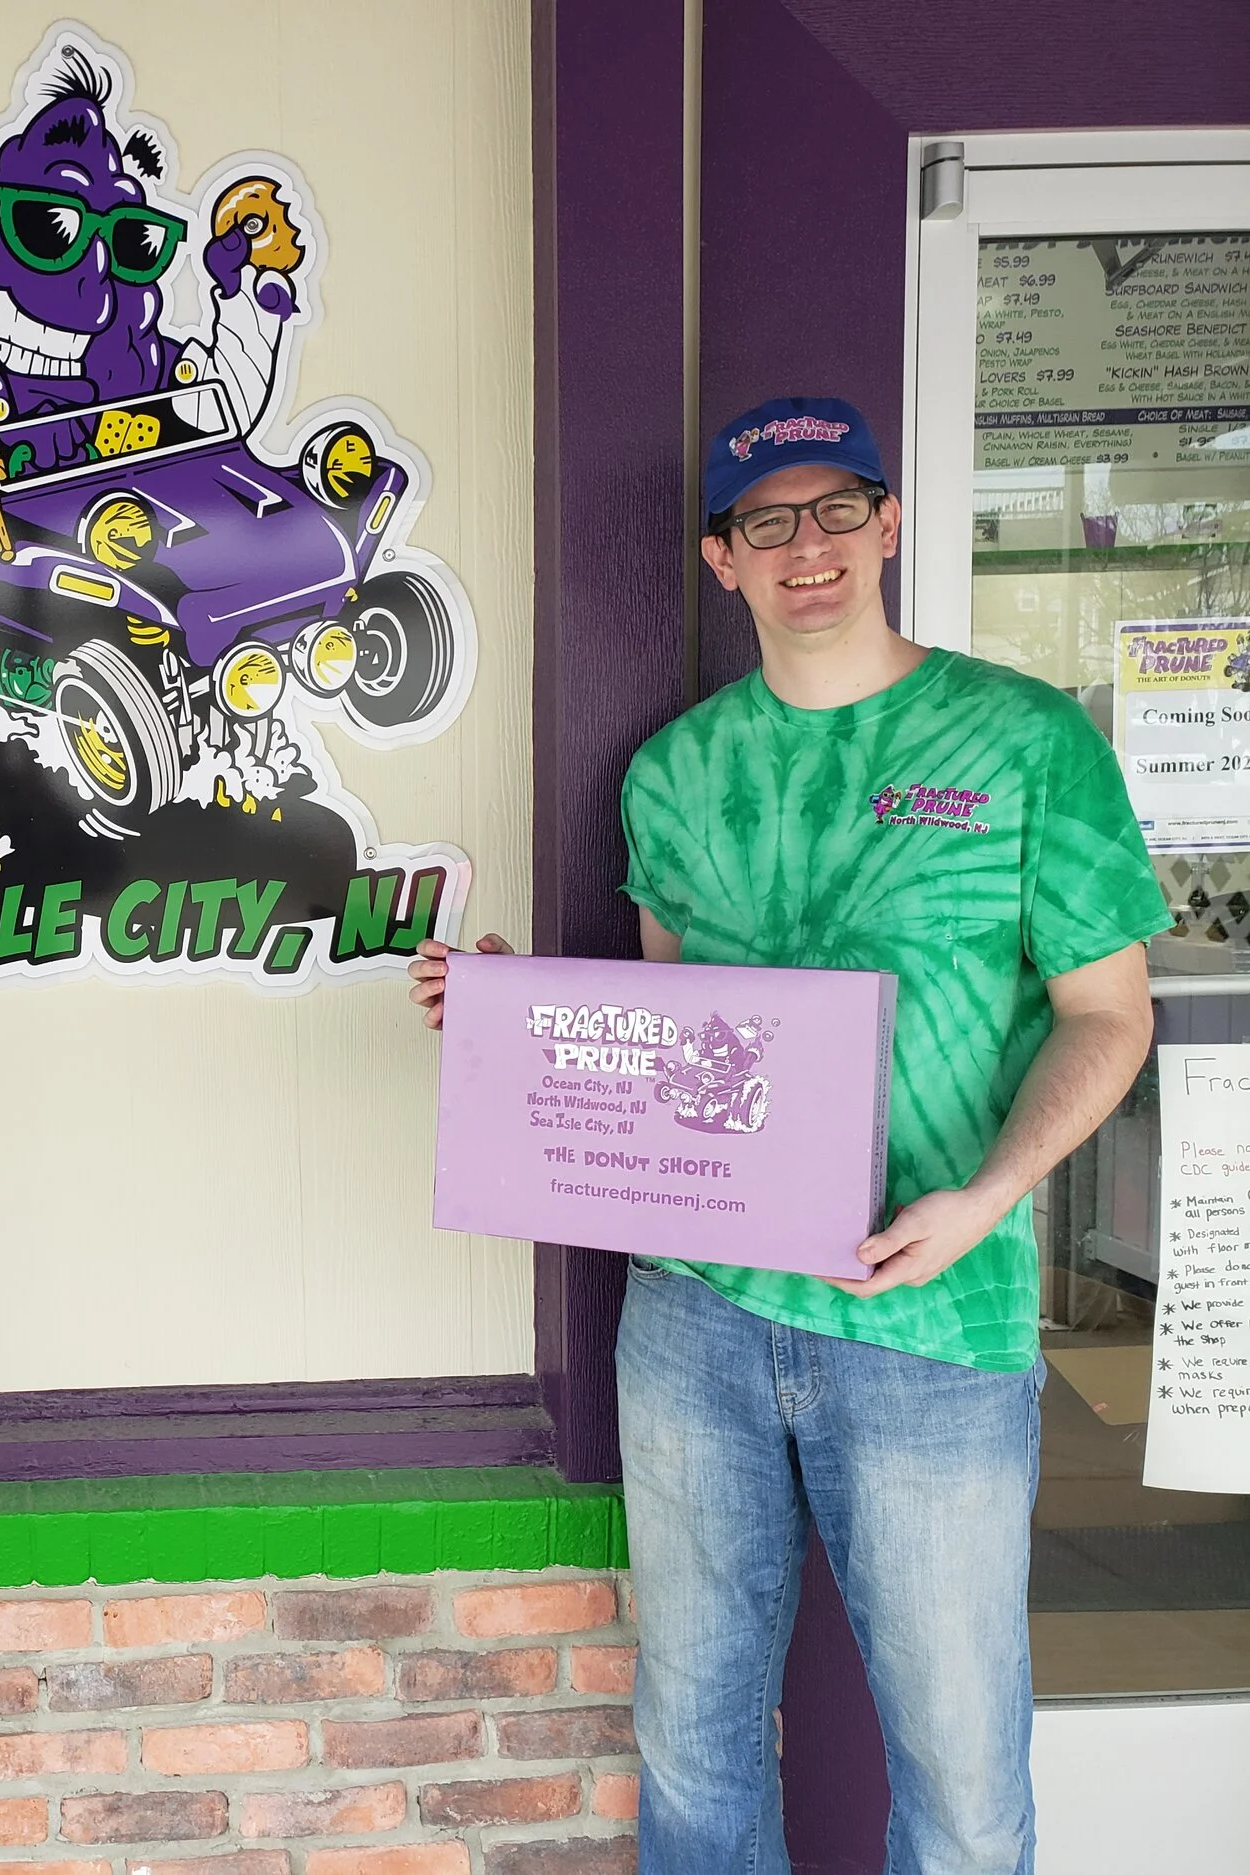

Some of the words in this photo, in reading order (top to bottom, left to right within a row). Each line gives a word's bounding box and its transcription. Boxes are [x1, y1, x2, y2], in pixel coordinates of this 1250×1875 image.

[993, 256, 1030, 268] $5.99
[1183, 267, 1209, 276] MEAT
[1213, 267, 1227, 276] ON
[1019, 274, 1056, 286] $6.99
[1185, 282, 1247, 294] SANDWICH
[1003, 293, 1040, 306] $7.49
[1136, 300, 1177, 309] CHEDDAR
[1222, 298, 1247, 307] HASH
[995, 310, 1027, 320] WHITE,
[1030, 308, 1064, 319] PESTO,
[1137, 311, 1163, 320] MEAT
[1168, 311, 1182, 320] ON
[1197, 309, 1235, 319] ENGLISH
[979, 321, 1005, 329] WRAP
[1115, 324, 1182, 337] SEASHORE
[1186, 323, 1247, 336] BENEDICT
[996, 331, 1033, 344] $7.49
[1150, 339, 1186, 349] CHEDDAR
[1125, 351, 1153, 361] WHEAT
[1155, 351, 1180, 360] BAGEL
[1183, 350, 1203, 359] WITH
[979, 359, 1007, 369] PESTO
[1010, 359, 1033, 368] WRAP
[980, 371, 1026, 383] LOVERS
[1036, 369, 1075, 382] $7.99
[1106, 365, 1159, 379] "KICKIN"
[1164, 365, 1199, 378] HASH
[1204, 364, 1250, 377] BROWN
[991, 387, 1014, 396] PORK
[1017, 386, 1039, 396] ROLL
[989, 399, 1020, 408] CHOICE
[1023, 398, 1036, 407] OF
[1038, 397, 1065, 407] BAGEL
[1131, 395, 1153, 404] WITH
[1155, 394, 1174, 403] HOT
[1177, 393, 1205, 402] SAUCE
[1000, 414, 1035, 425] MUFFINS,
[1038, 413, 1080, 424] MULTIGRAIN
[1082, 411, 1106, 422] BREAD
[1138, 410, 1168, 421] CHOICE
[1170, 410, 1183, 420] OF
[1185, 409, 1212, 420] MEAT:
[760, 416, 850, 441] FRACTURED
[1019, 430, 1050, 440] WHOLE
[1054, 429, 1089, 439] WHEAT,
[1092, 428, 1133, 438] SESAME,
[1178, 424, 1219, 433] SINGLE
[774, 426, 842, 446] PRUNE
[983, 442, 1033, 451] CINNAMON
[1073, 438, 1132, 449] EVERYTHING)
[984, 457, 1011, 468] BAGEL
[1028, 456, 1057, 466] CREAM
[1060, 454, 1091, 465] CHEESE
[1176, 452, 1201, 463] BAGEL
[1127, 636, 1228, 658] FRACTURED
[1139, 653, 1213, 675] PRUNE
[1137, 676, 1152, 684] THE
[1142, 708, 1215, 727] Coming
[1136, 758, 1215, 774] Summer
[905, 783, 991, 805] FRACTURED
[911, 797, 976, 818] PRUNE
[890, 815, 916, 825] North
[919, 816, 971, 833] Wildwood,
[974, 822, 990, 835] NJ
[104, 876, 312, 973] CITY,
[333, 867, 445, 958] NJ
[526, 1003, 678, 1048] FRACTURED
[553, 1043, 658, 1077] PRUNE
[541, 1075, 581, 1091] Ocean
[583, 1079, 613, 1096] City,
[615, 1081, 633, 1095] NJ
[527, 1091, 561, 1108] North
[563, 1095, 627, 1115] Wildwood,
[629, 1100, 647, 1115] NJ
[530, 1110, 554, 1128] Sea
[555, 1112, 582, 1131] Isle
[584, 1118, 614, 1136] City,
[617, 1120, 635, 1135] NJ
[1181, 1141, 1225, 1159] Please
[544, 1146, 576, 1165] THE
[584, 1150, 650, 1172] DONUT
[658, 1157, 732, 1179] SHOPPE
[1180, 1164, 1212, 1176] CDC
[550, 1177, 746, 1215] fracturedprunenj.com
[1186, 1196, 1234, 1207] Maintain
[1185, 1208, 1200, 1219] all
[1206, 1206, 1246, 1222] persons
[1187, 1226, 1240, 1240] Designated
[1207, 1242, 1239, 1254] floor
[1185, 1264, 1216, 1277] Please
[1173, 1281, 1200, 1295] guest
[1204, 1278, 1215, 1289] in
[1217, 1277, 1249, 1287] front
[1181, 1300, 1202, 1311] We
[1206, 1298, 1244, 1312] provide
[1181, 1320, 1203, 1331] We
[1173, 1334, 1195, 1347] the
[1181, 1356, 1204, 1368] We
[1212, 1357, 1248, 1367] require
[1178, 1371, 1223, 1381] masks
[1179, 1386, 1203, 1399] We
